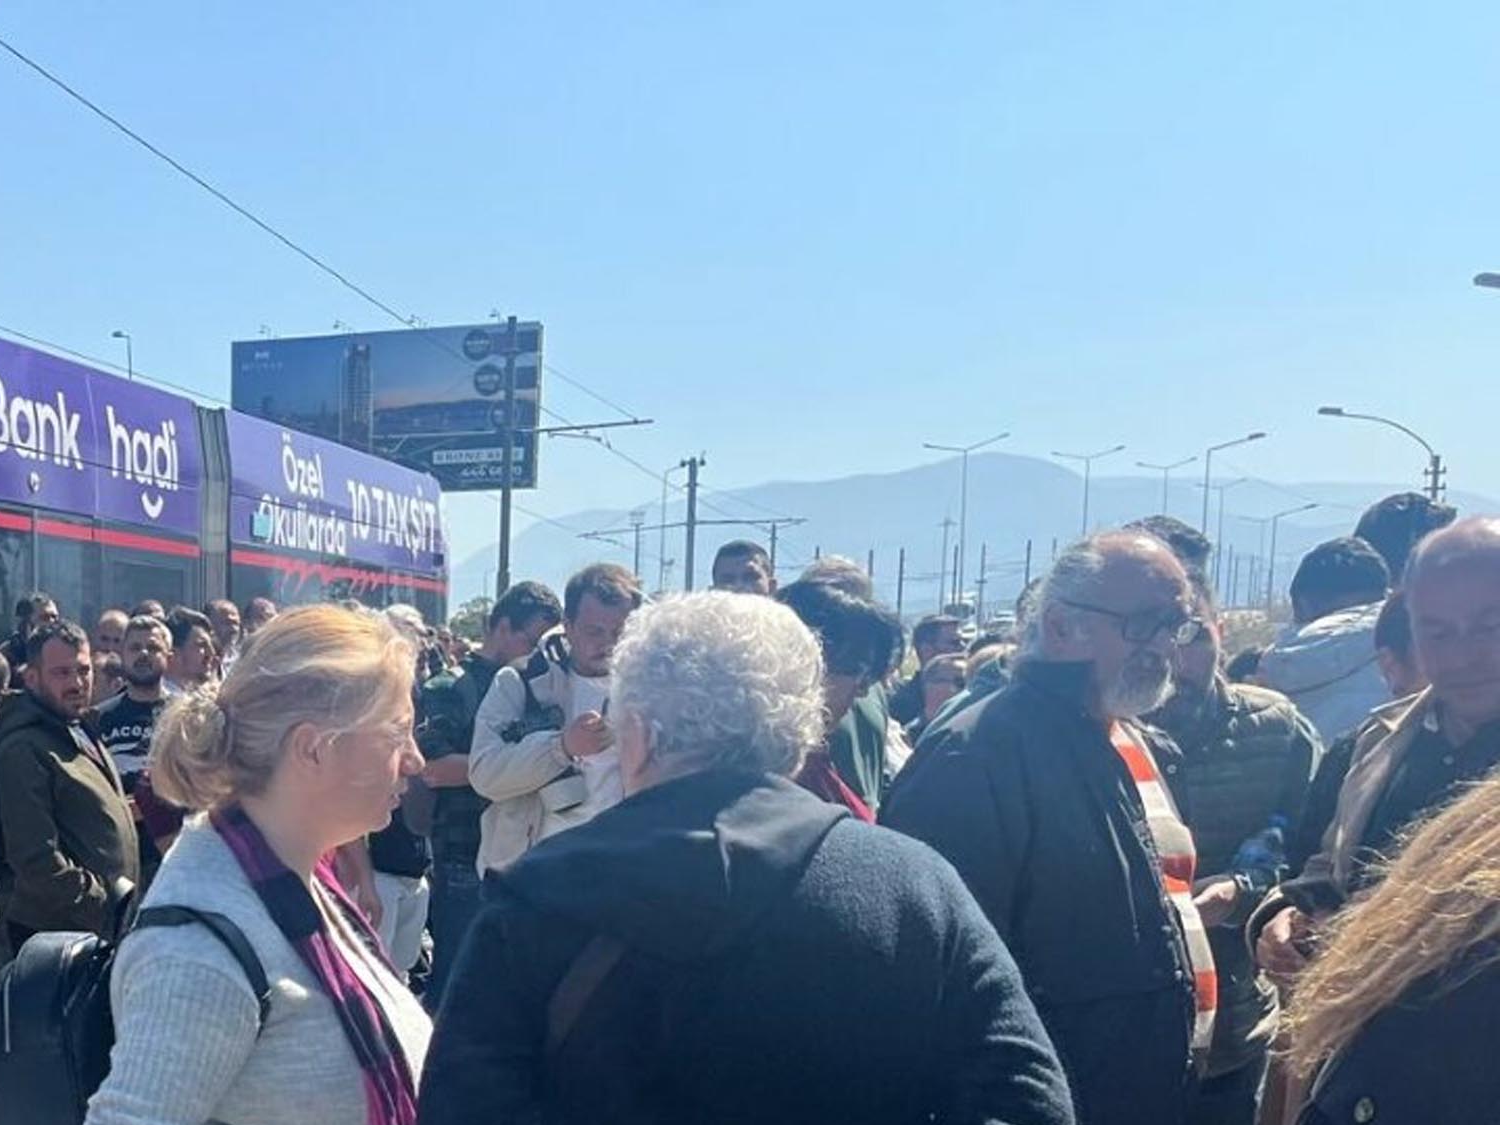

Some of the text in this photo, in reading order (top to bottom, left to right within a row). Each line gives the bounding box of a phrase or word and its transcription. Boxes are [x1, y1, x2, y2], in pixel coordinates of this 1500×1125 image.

[106, 405, 180, 491] hadi
[282, 433, 325, 498] Özel
[347, 480, 371, 539] 10
